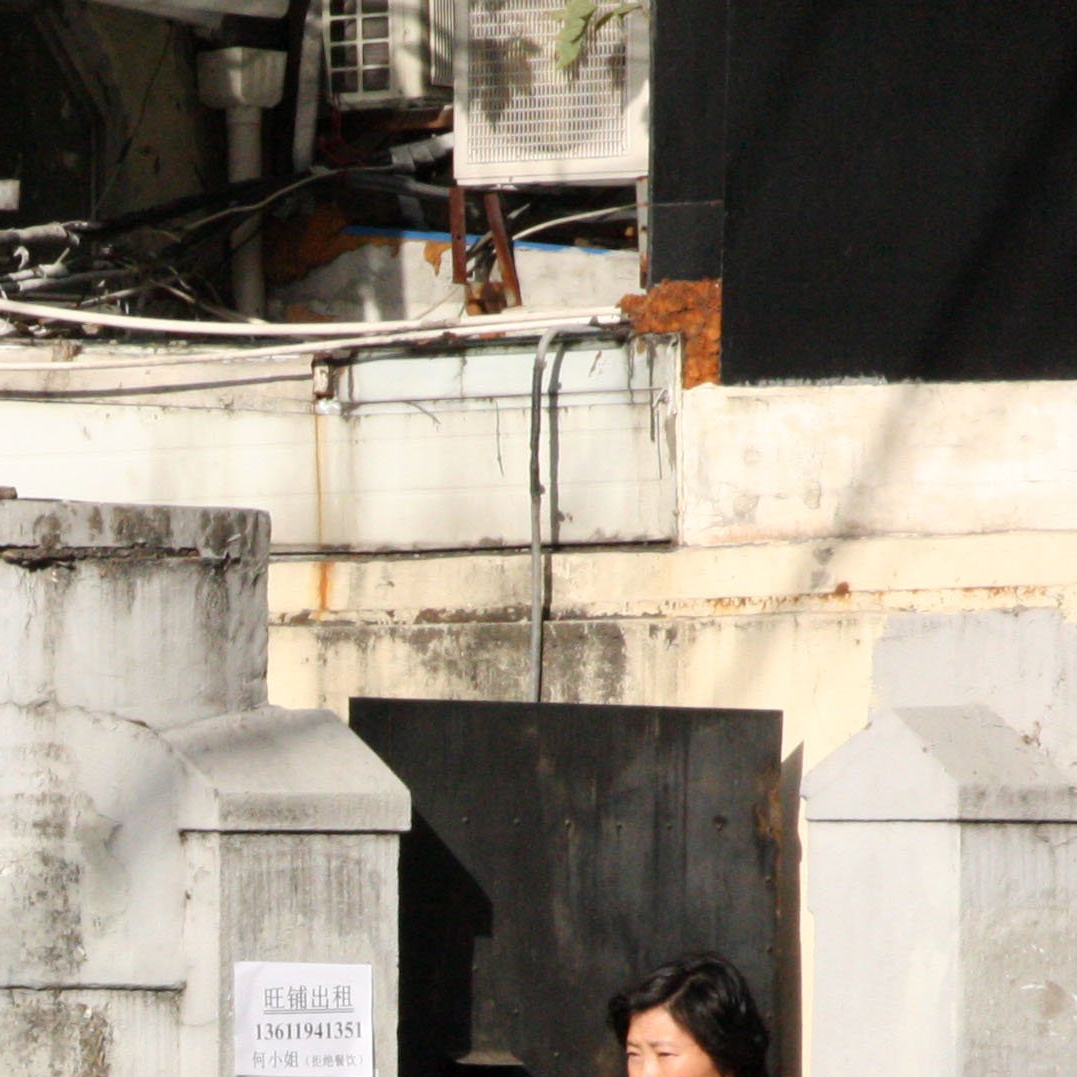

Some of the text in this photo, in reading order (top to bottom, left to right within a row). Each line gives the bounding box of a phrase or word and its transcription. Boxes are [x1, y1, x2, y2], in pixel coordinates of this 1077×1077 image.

[264, 985, 353, 1010] 旺铺出租
[256, 1021, 362, 1040] 13611941351
